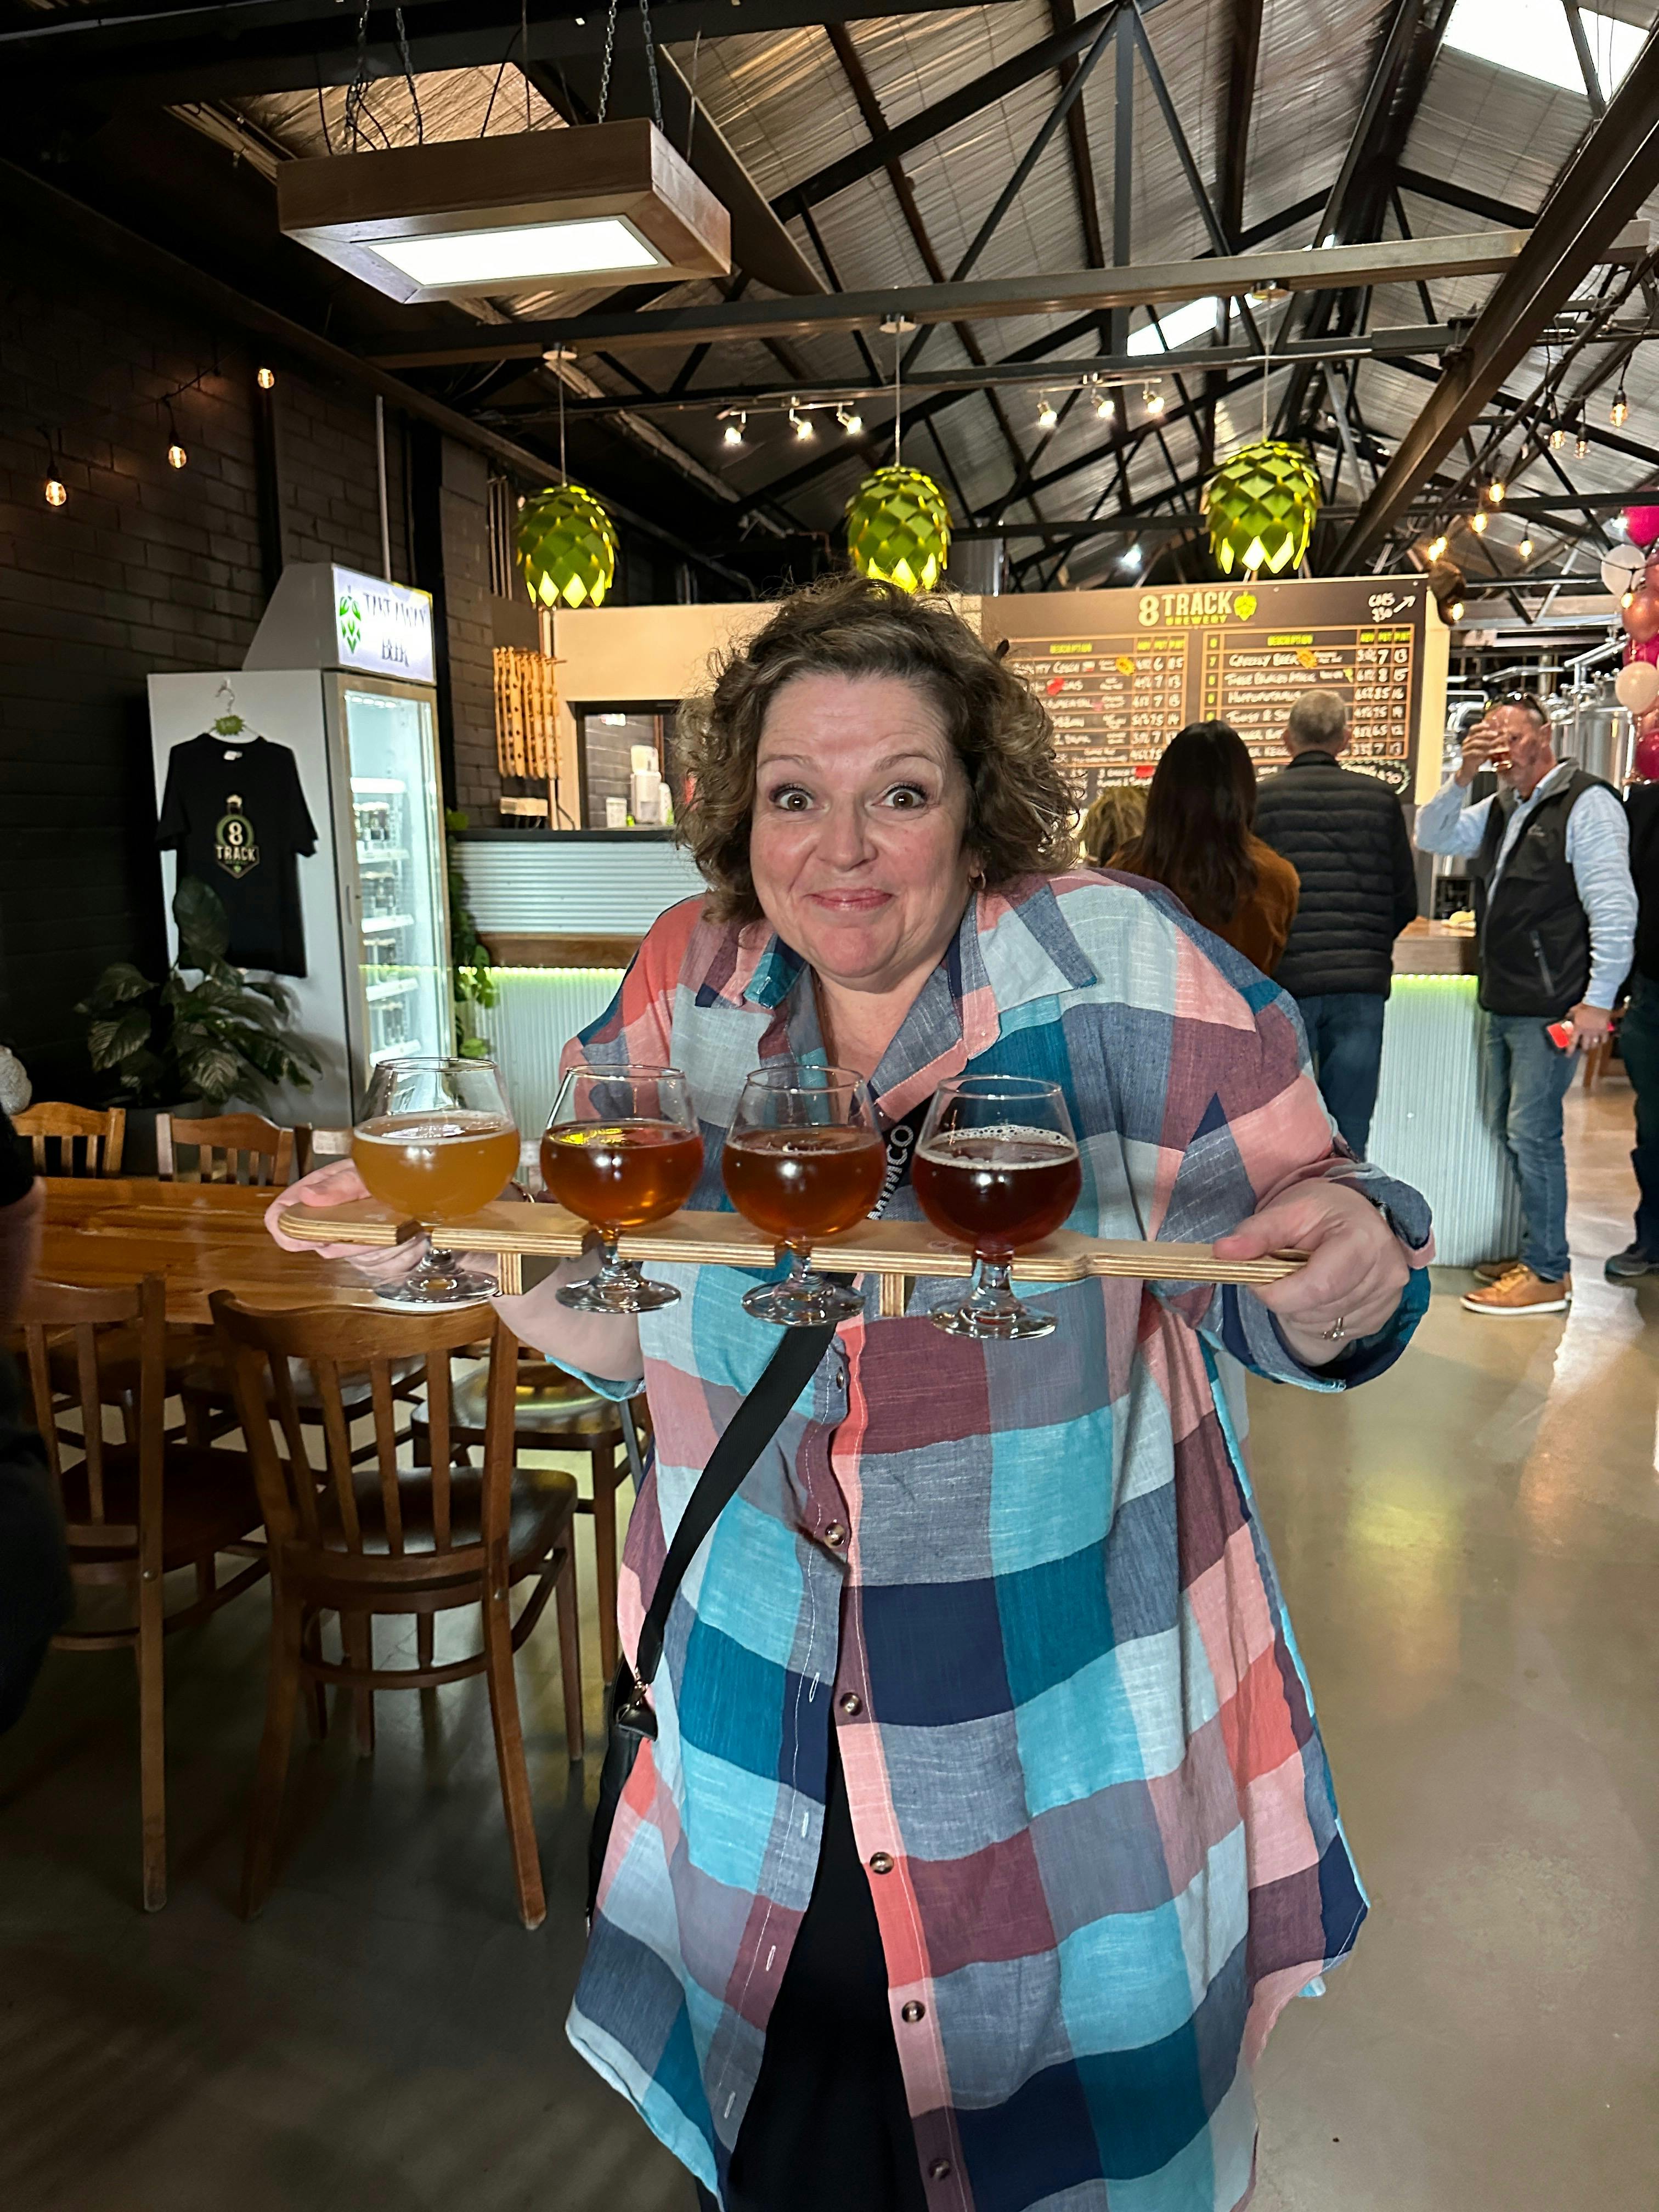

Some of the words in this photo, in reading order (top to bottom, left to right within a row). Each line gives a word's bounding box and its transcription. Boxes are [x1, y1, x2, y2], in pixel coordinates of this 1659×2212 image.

[1138, 595, 1160, 627] 8
[1161, 590, 1233, 617] TRACK
[1165, 614, 1228, 626] BREWERY
[1378, 649, 1389, 665] 7
[1374, 742, 1385, 755] 7
[229, 821, 243, 845] 8
[216, 845, 256, 862] TRACK
